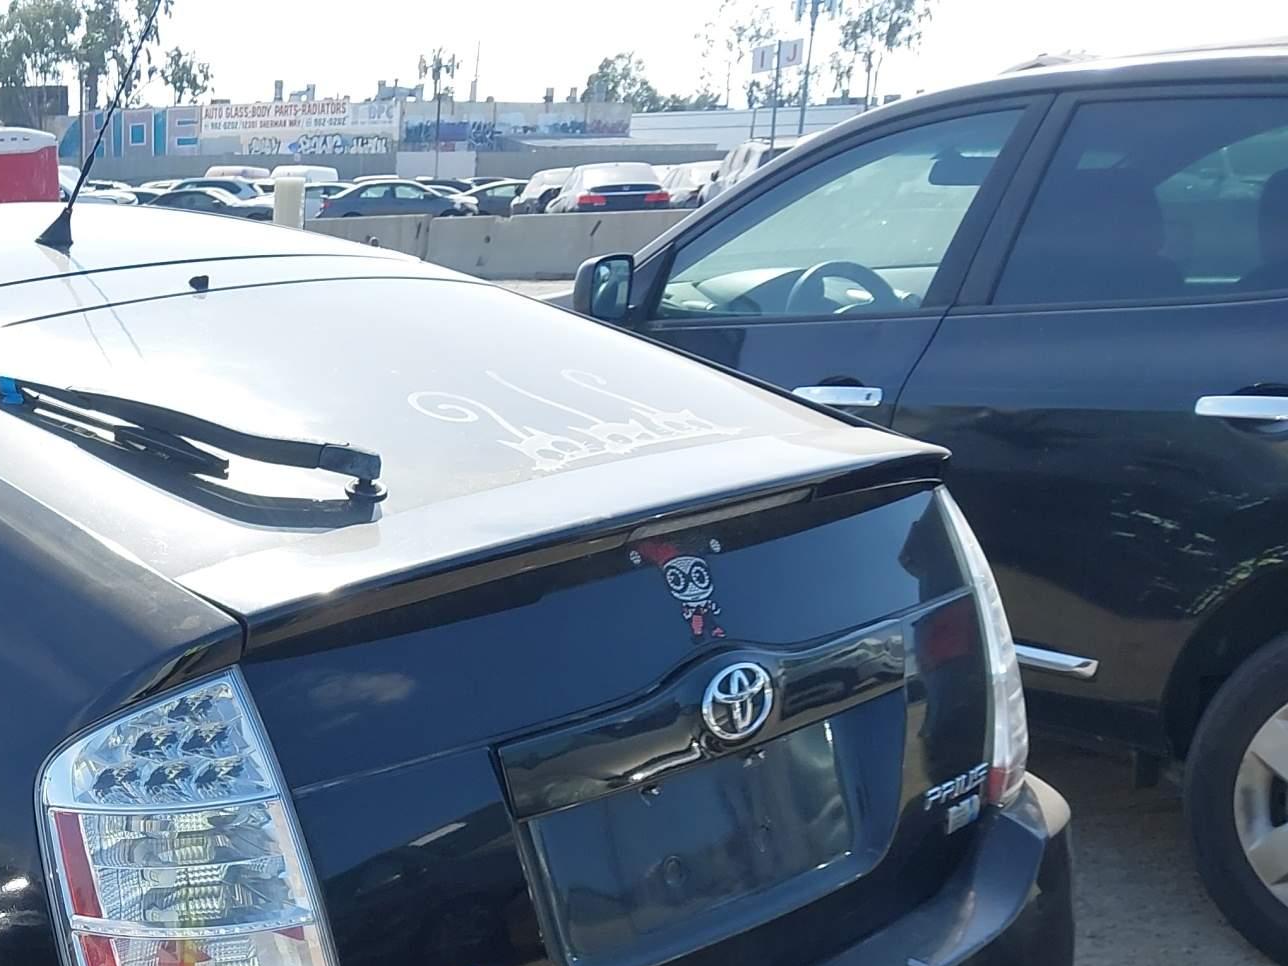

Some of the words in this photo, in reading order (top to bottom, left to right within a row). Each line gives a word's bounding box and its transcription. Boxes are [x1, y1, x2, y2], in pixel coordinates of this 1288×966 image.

[786, 43, 798, 62] J
[204, 106, 223, 119] AUTO
[923, 761, 990, 812] PRIUS
